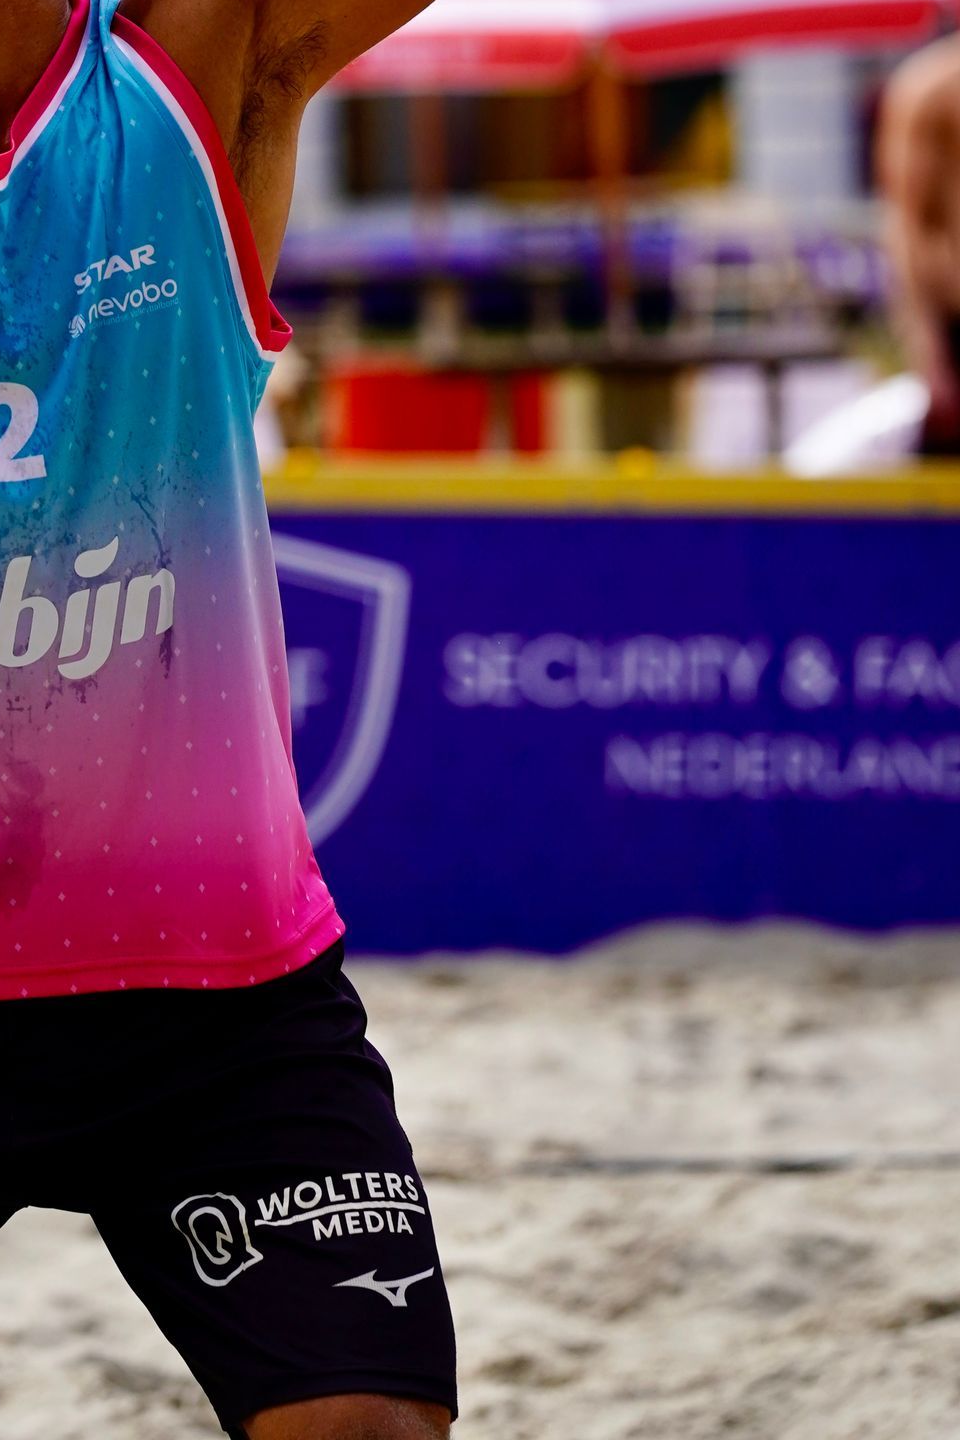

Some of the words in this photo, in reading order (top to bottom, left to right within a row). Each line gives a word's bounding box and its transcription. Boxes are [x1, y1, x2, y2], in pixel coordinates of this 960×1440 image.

[74, 244, 157, 295] STAR
[88, 278, 178, 324] nevobo
[443, 632, 766, 708] SECURITY
[257, 1171, 419, 1221] WOLTERS
[312, 1210, 413, 1242] MEDIA
